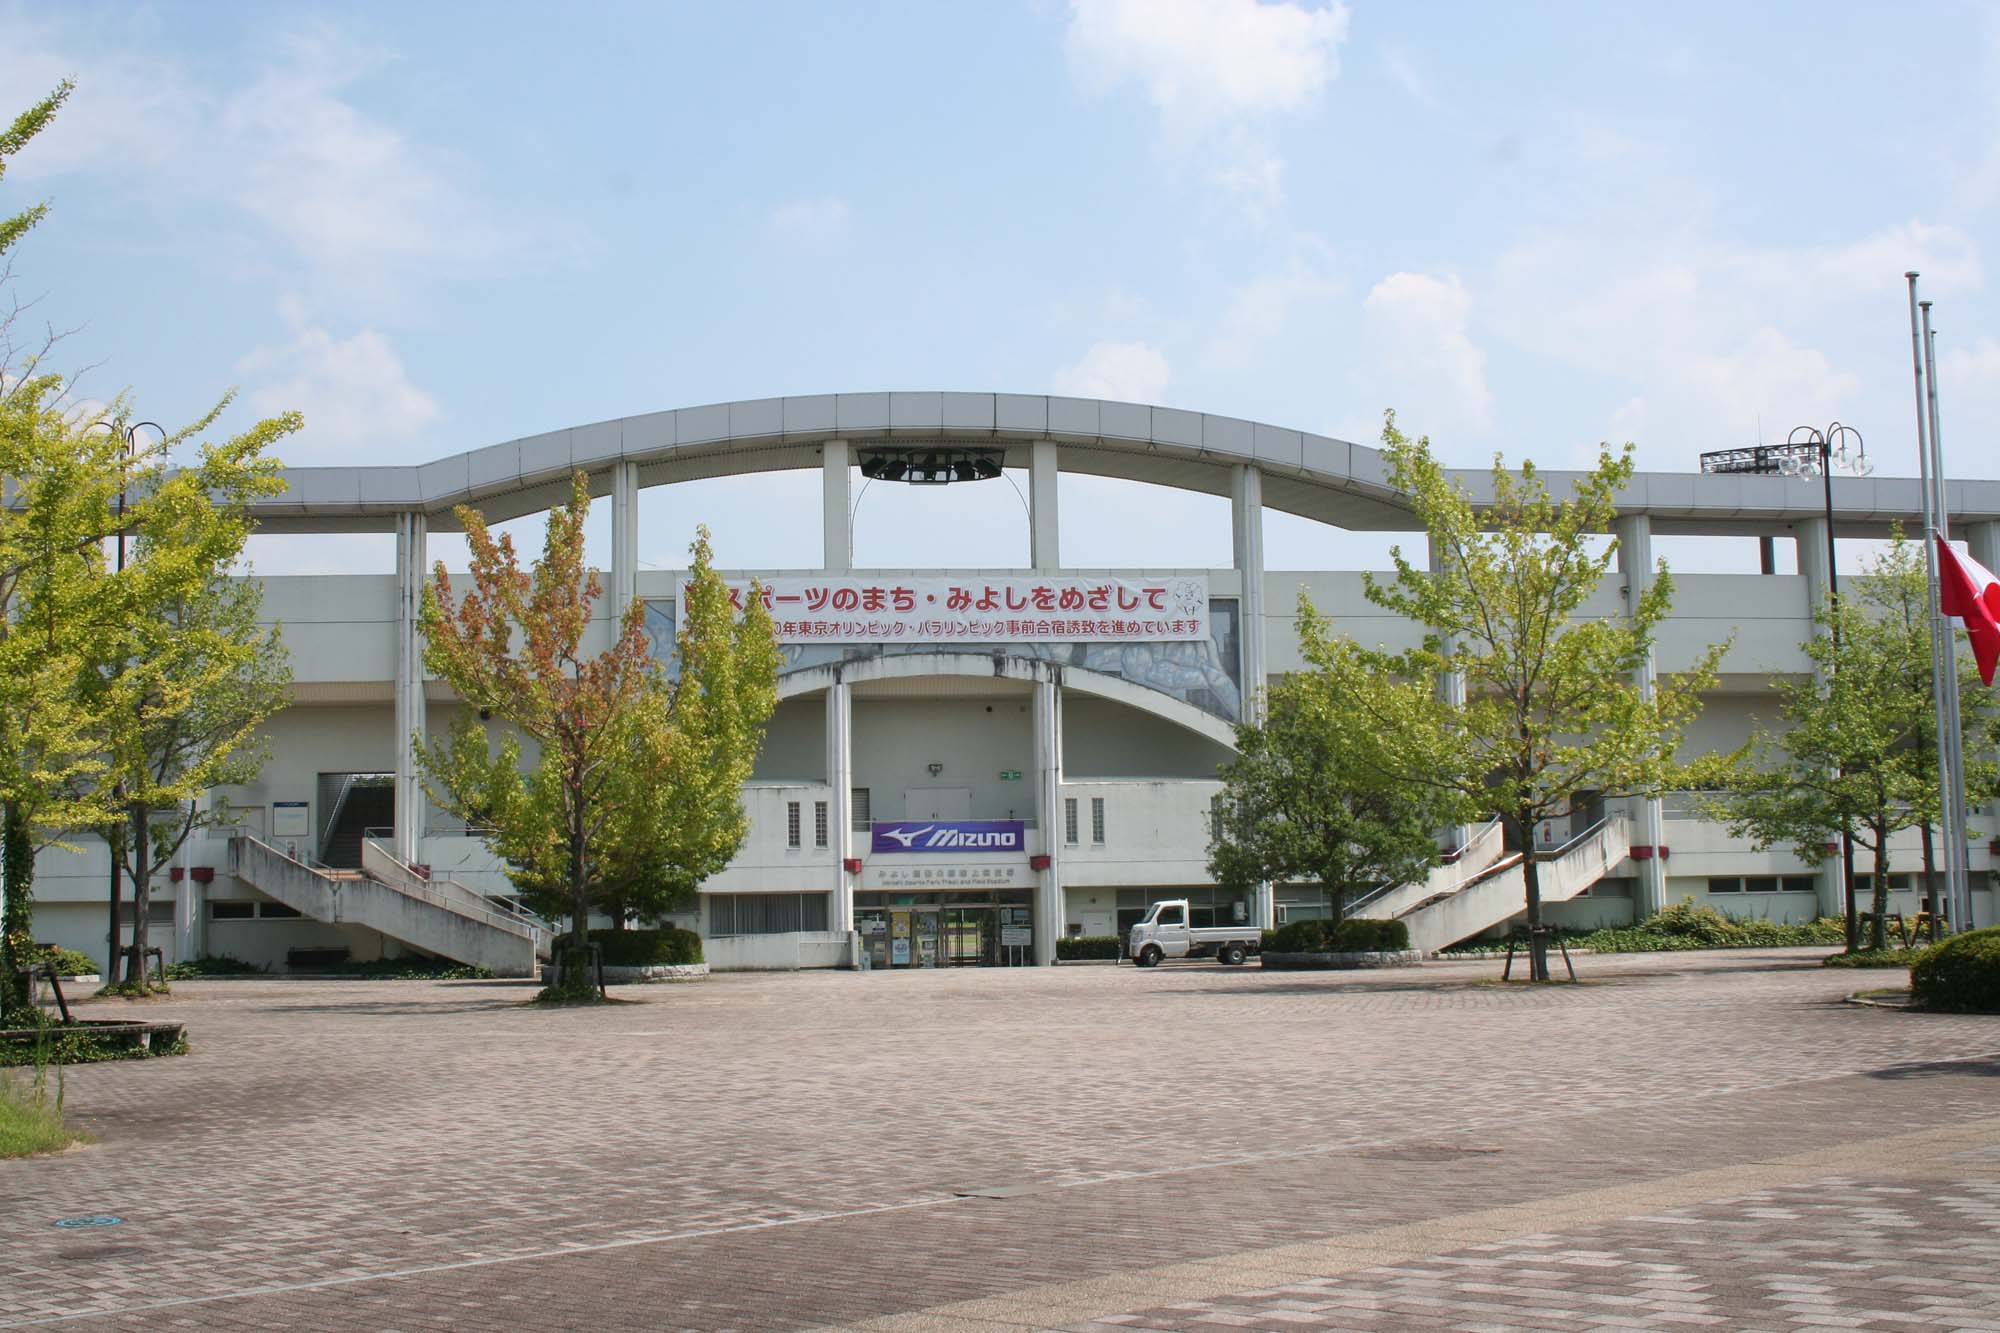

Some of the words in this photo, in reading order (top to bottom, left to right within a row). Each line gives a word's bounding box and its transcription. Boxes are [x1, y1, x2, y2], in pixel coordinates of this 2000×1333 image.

[685, 584, 1166, 613] スポーツのまち・みよしをめざして
[774, 619, 1199, 635] 0年東京オリンピック・パラリンピック事前合宿誘致を進めています
